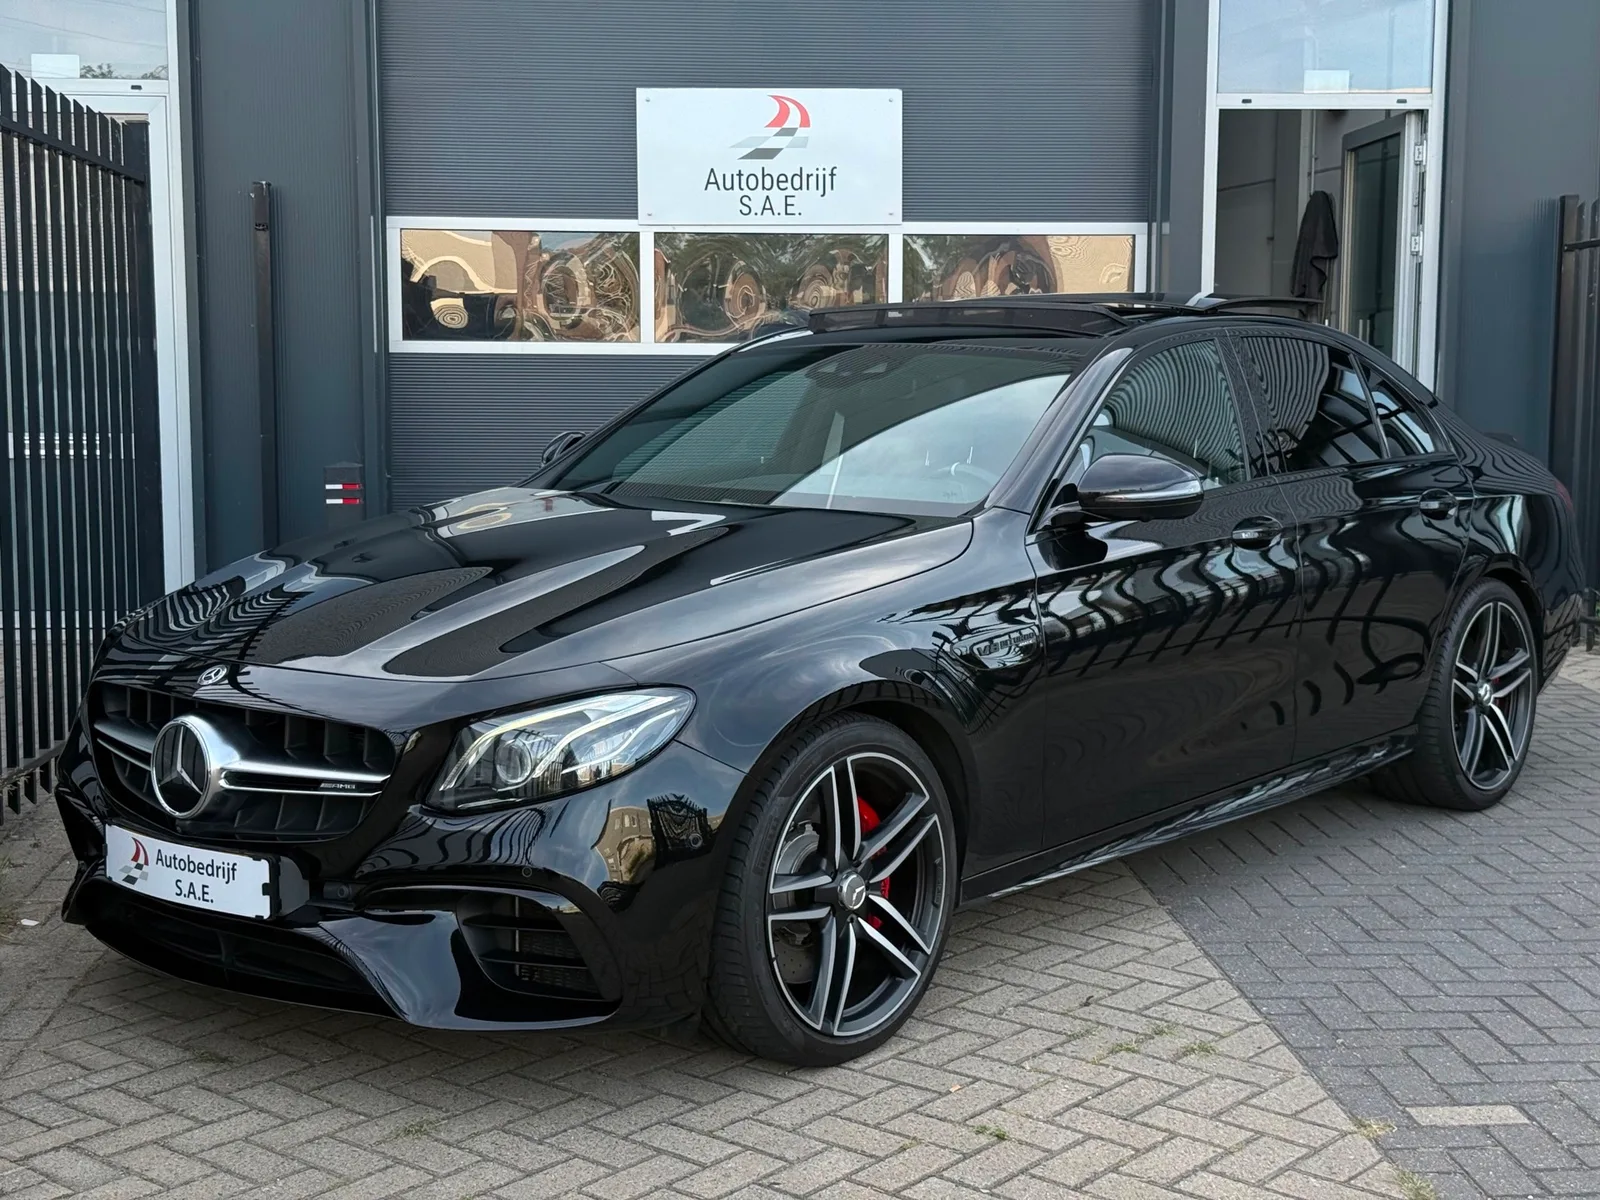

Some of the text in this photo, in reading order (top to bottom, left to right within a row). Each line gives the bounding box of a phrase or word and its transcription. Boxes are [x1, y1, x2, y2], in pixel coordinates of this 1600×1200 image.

[704, 167, 838, 197] Autobedrijf
[739, 195, 802, 216] S.A.E.
[155, 849, 237, 884] Autobedrijf
[175, 879, 214, 904] S.A.E.
